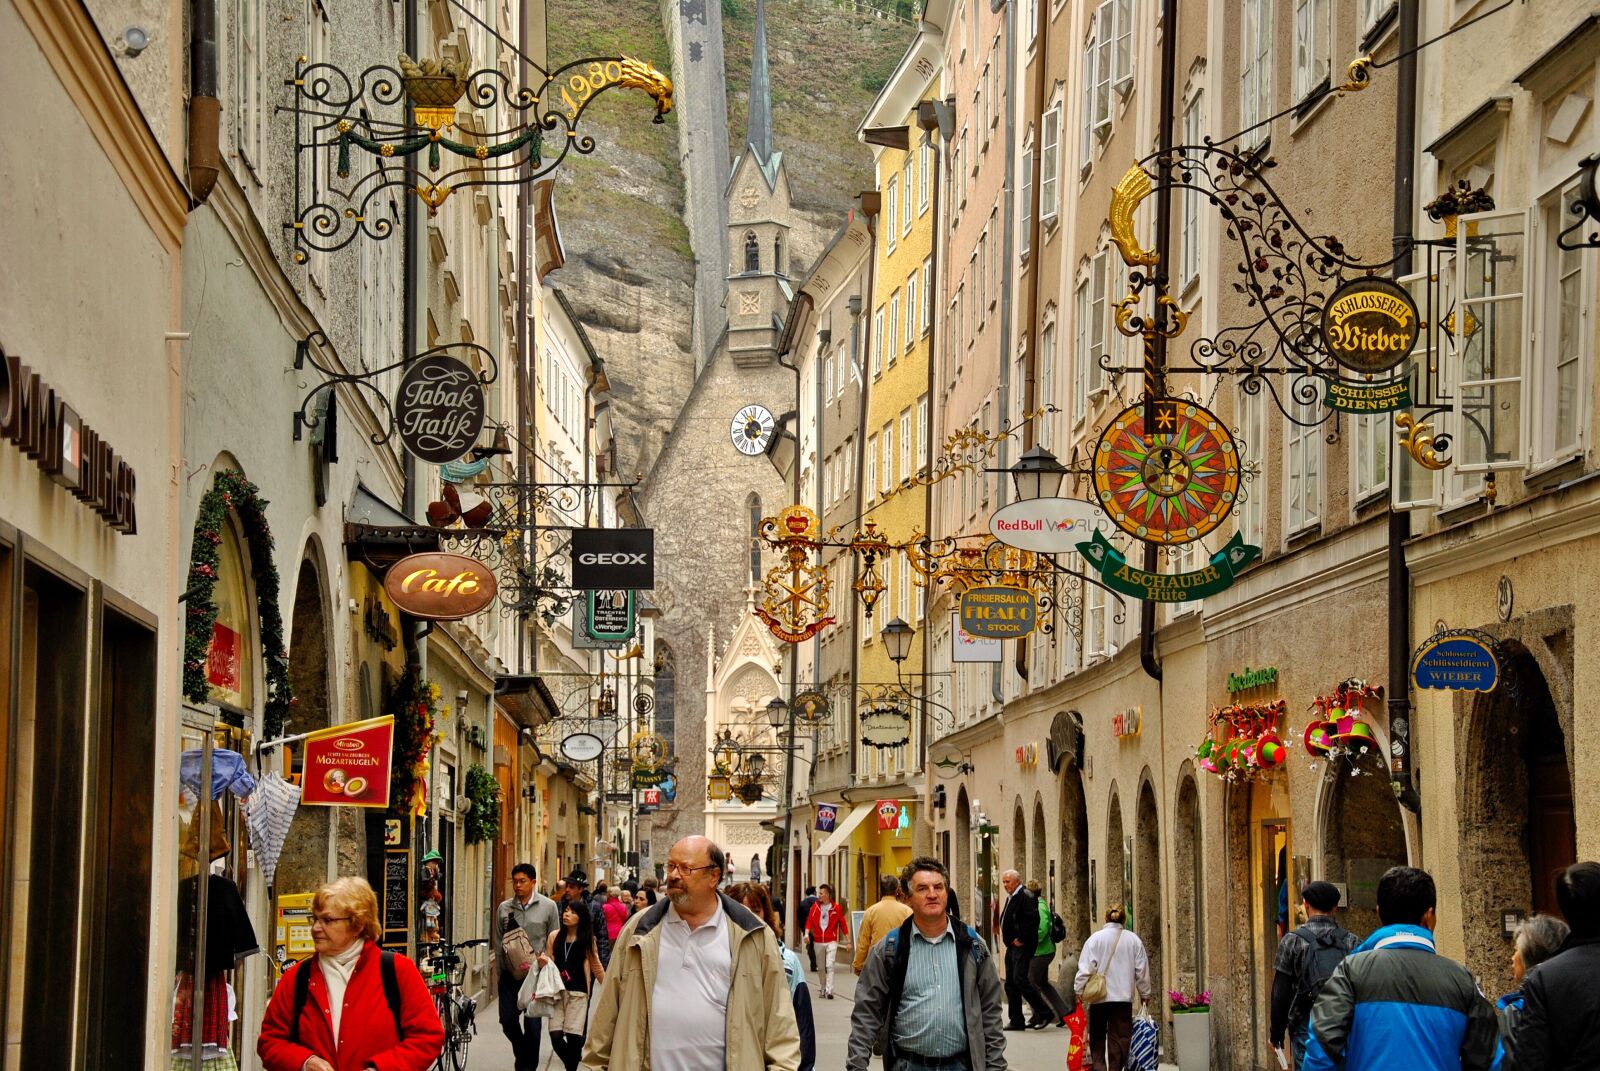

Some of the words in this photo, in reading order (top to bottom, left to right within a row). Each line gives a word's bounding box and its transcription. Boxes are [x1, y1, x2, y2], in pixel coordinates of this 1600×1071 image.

[561, 62, 621, 119] 1980
[1334, 295, 1408, 319] SCHLOSSEREI
[1329, 322, 1411, 351] Wieber
[404, 378, 479, 410] Tabak
[1330, 384, 1407, 399] SCHLÜSSEL
[1335, 397, 1398, 410] DIENST
[402, 408, 476, 440] Trafik
[997, 520, 1019, 530] Red
[1022, 520, 1042, 530] Bull
[1046, 517, 1108, 532] WORLD
[579, 553, 647, 565] GEOX
[401, 569, 480, 597] Café
[1114, 565, 1220, 589] ASCHAUER
[968, 593, 1029, 604] FRISIERSALON
[1146, 587, 1187, 601] Hüte
[965, 606, 1032, 620] FIGARO
[987, 624, 1020, 632] STOCK
[1437, 649, 1477, 658] Schlosserei
[1423, 659, 1490, 668] Schlüsseldienst
[1430, 671, 1481, 681] WIEBER
[316, 754, 379, 766] MOZARTKUGELN
